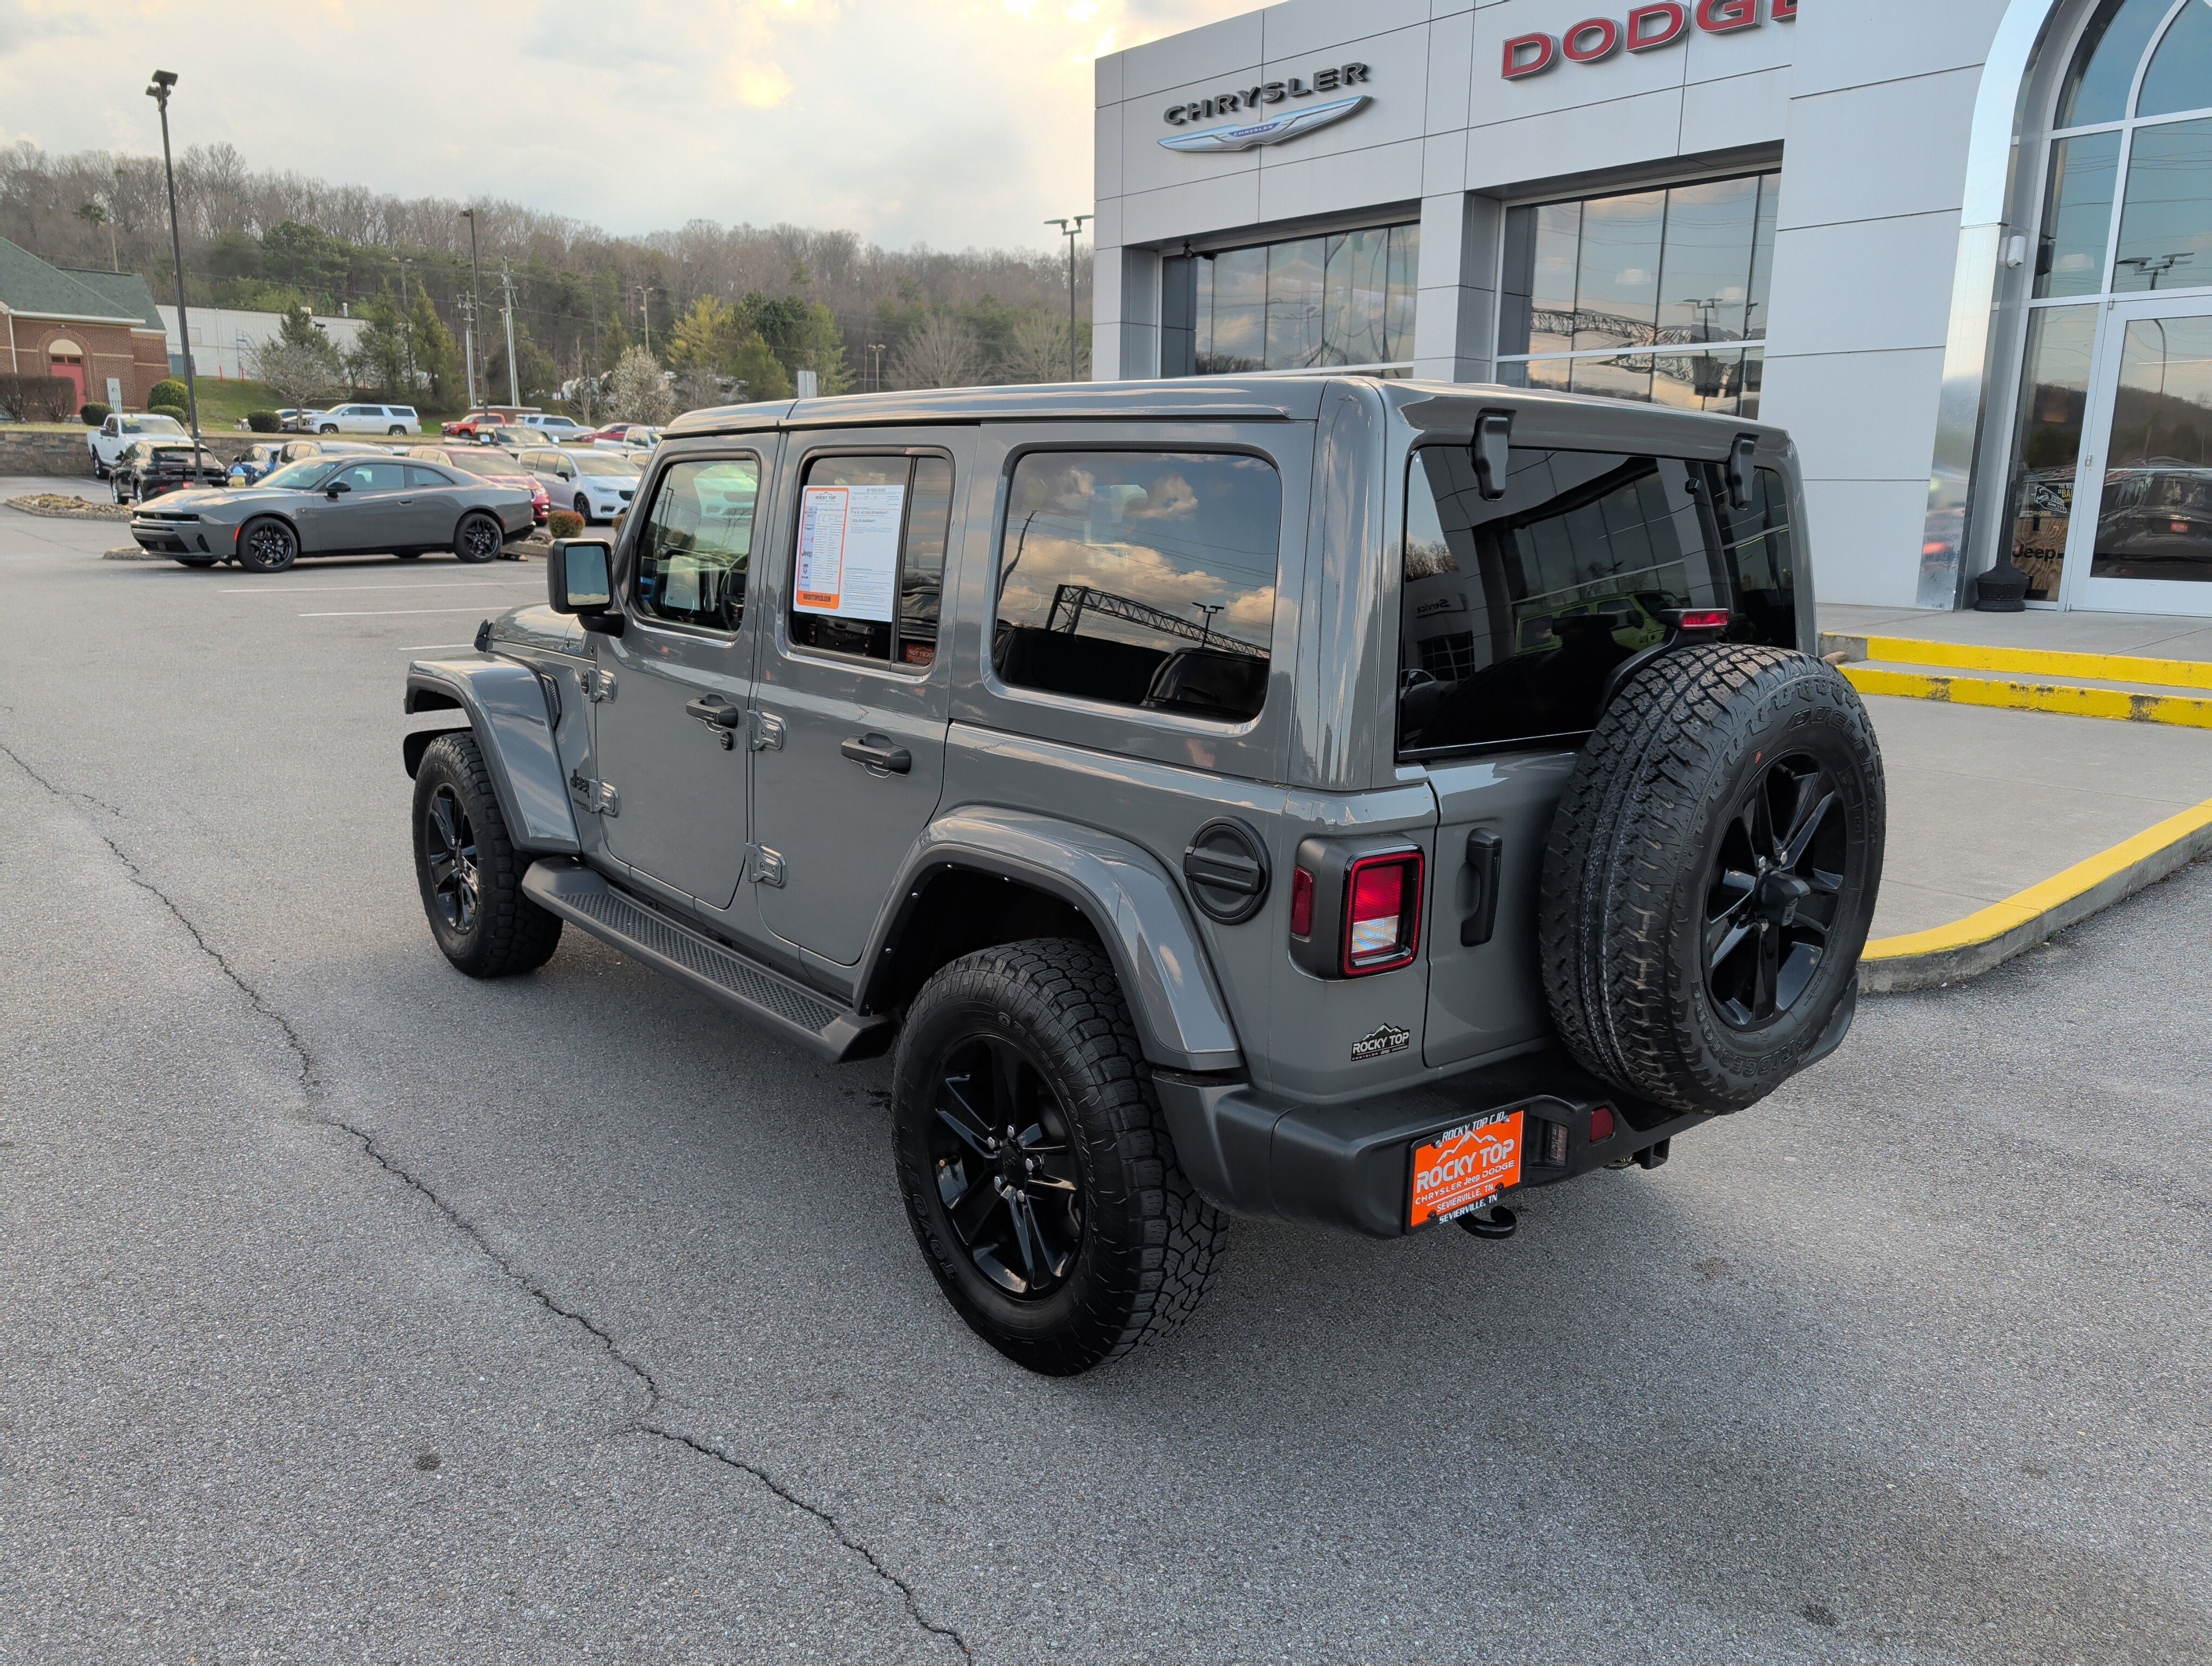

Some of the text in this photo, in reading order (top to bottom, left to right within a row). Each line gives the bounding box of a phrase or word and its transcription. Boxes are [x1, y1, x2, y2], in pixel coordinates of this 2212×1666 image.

[1501, 0, 1797, 81] DODG
[1163, 61, 1368, 125] CHRYSLER
[1233, 125, 1274, 137] CHRYSLER
[801, 548, 813, 559] Jeep
[2012, 544, 2056, 561] Jeep
[1788, 706, 1876, 787] DUELER
[1353, 1031, 1410, 1054] ROCKY TOP
[1442, 1111, 1505, 1142] ROCKY TOP CJD
[1416, 1151, 1477, 1194] ROCKY
[1479, 1138, 1515, 1168] TOP
[1415, 1159, 1515, 1205] CHRYSLER Jeep DODGE
[1437, 1183, 1494, 1212] SEVIERVILLE, TN
[1488, 1193, 1498, 1203] TN
